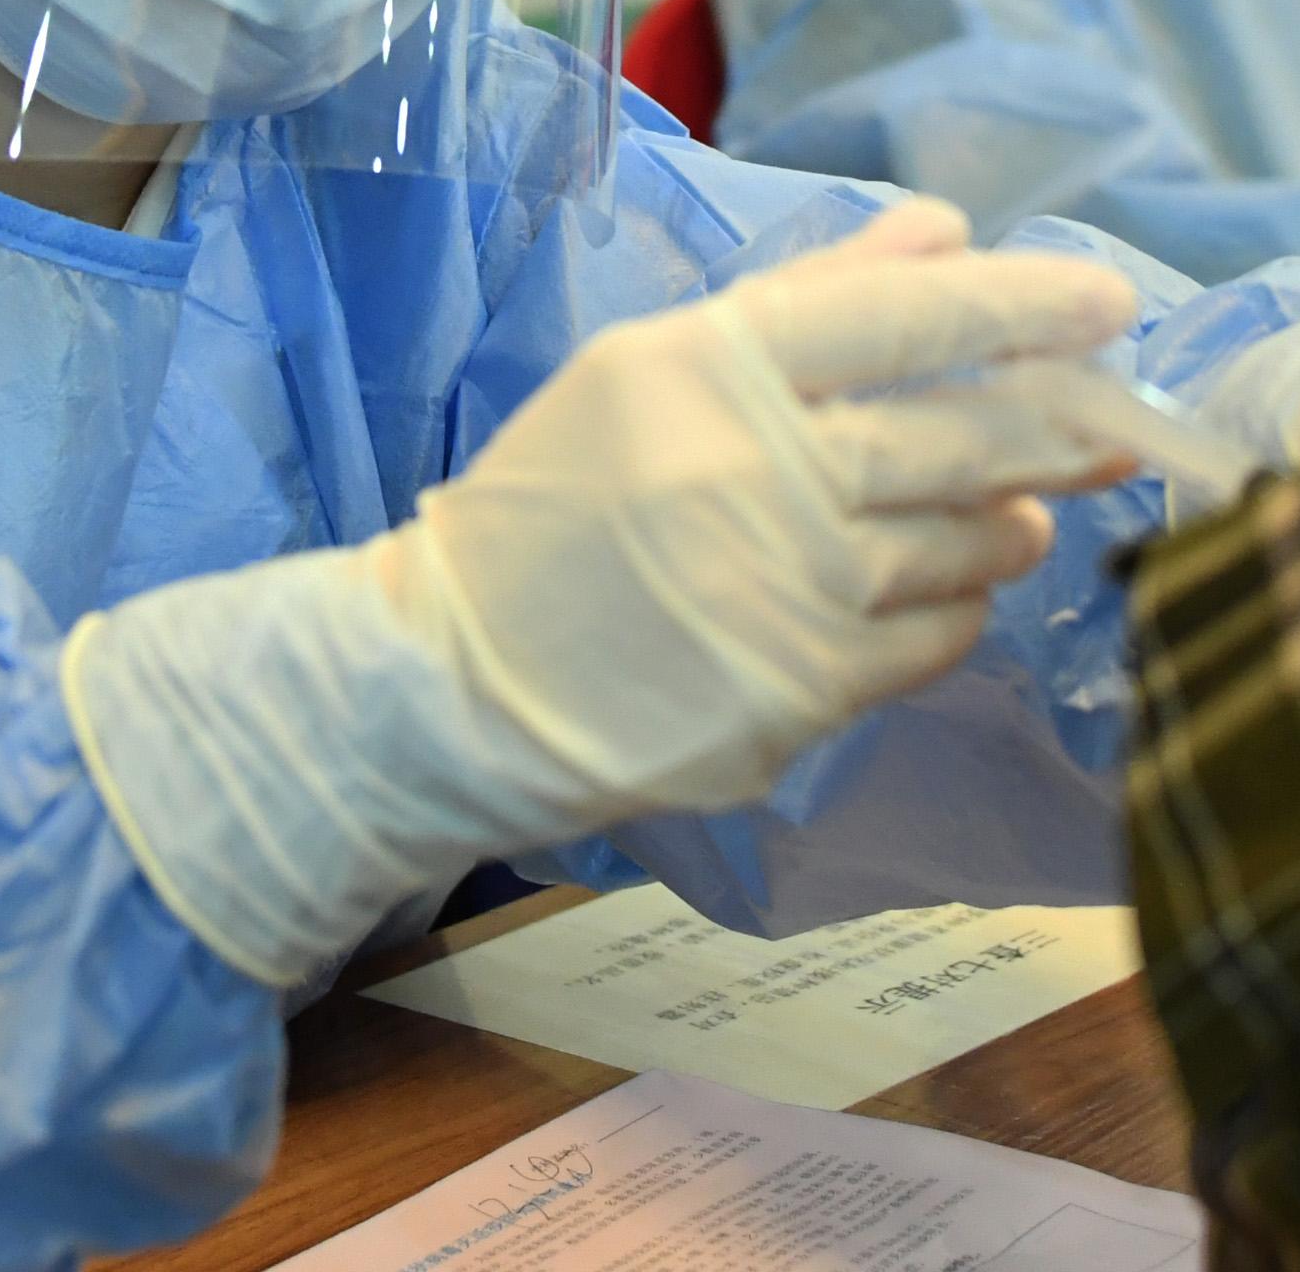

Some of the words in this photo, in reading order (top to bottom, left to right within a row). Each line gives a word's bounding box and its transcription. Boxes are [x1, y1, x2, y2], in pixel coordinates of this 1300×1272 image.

[854, 929, 1061, 1016] 三查七对提示
